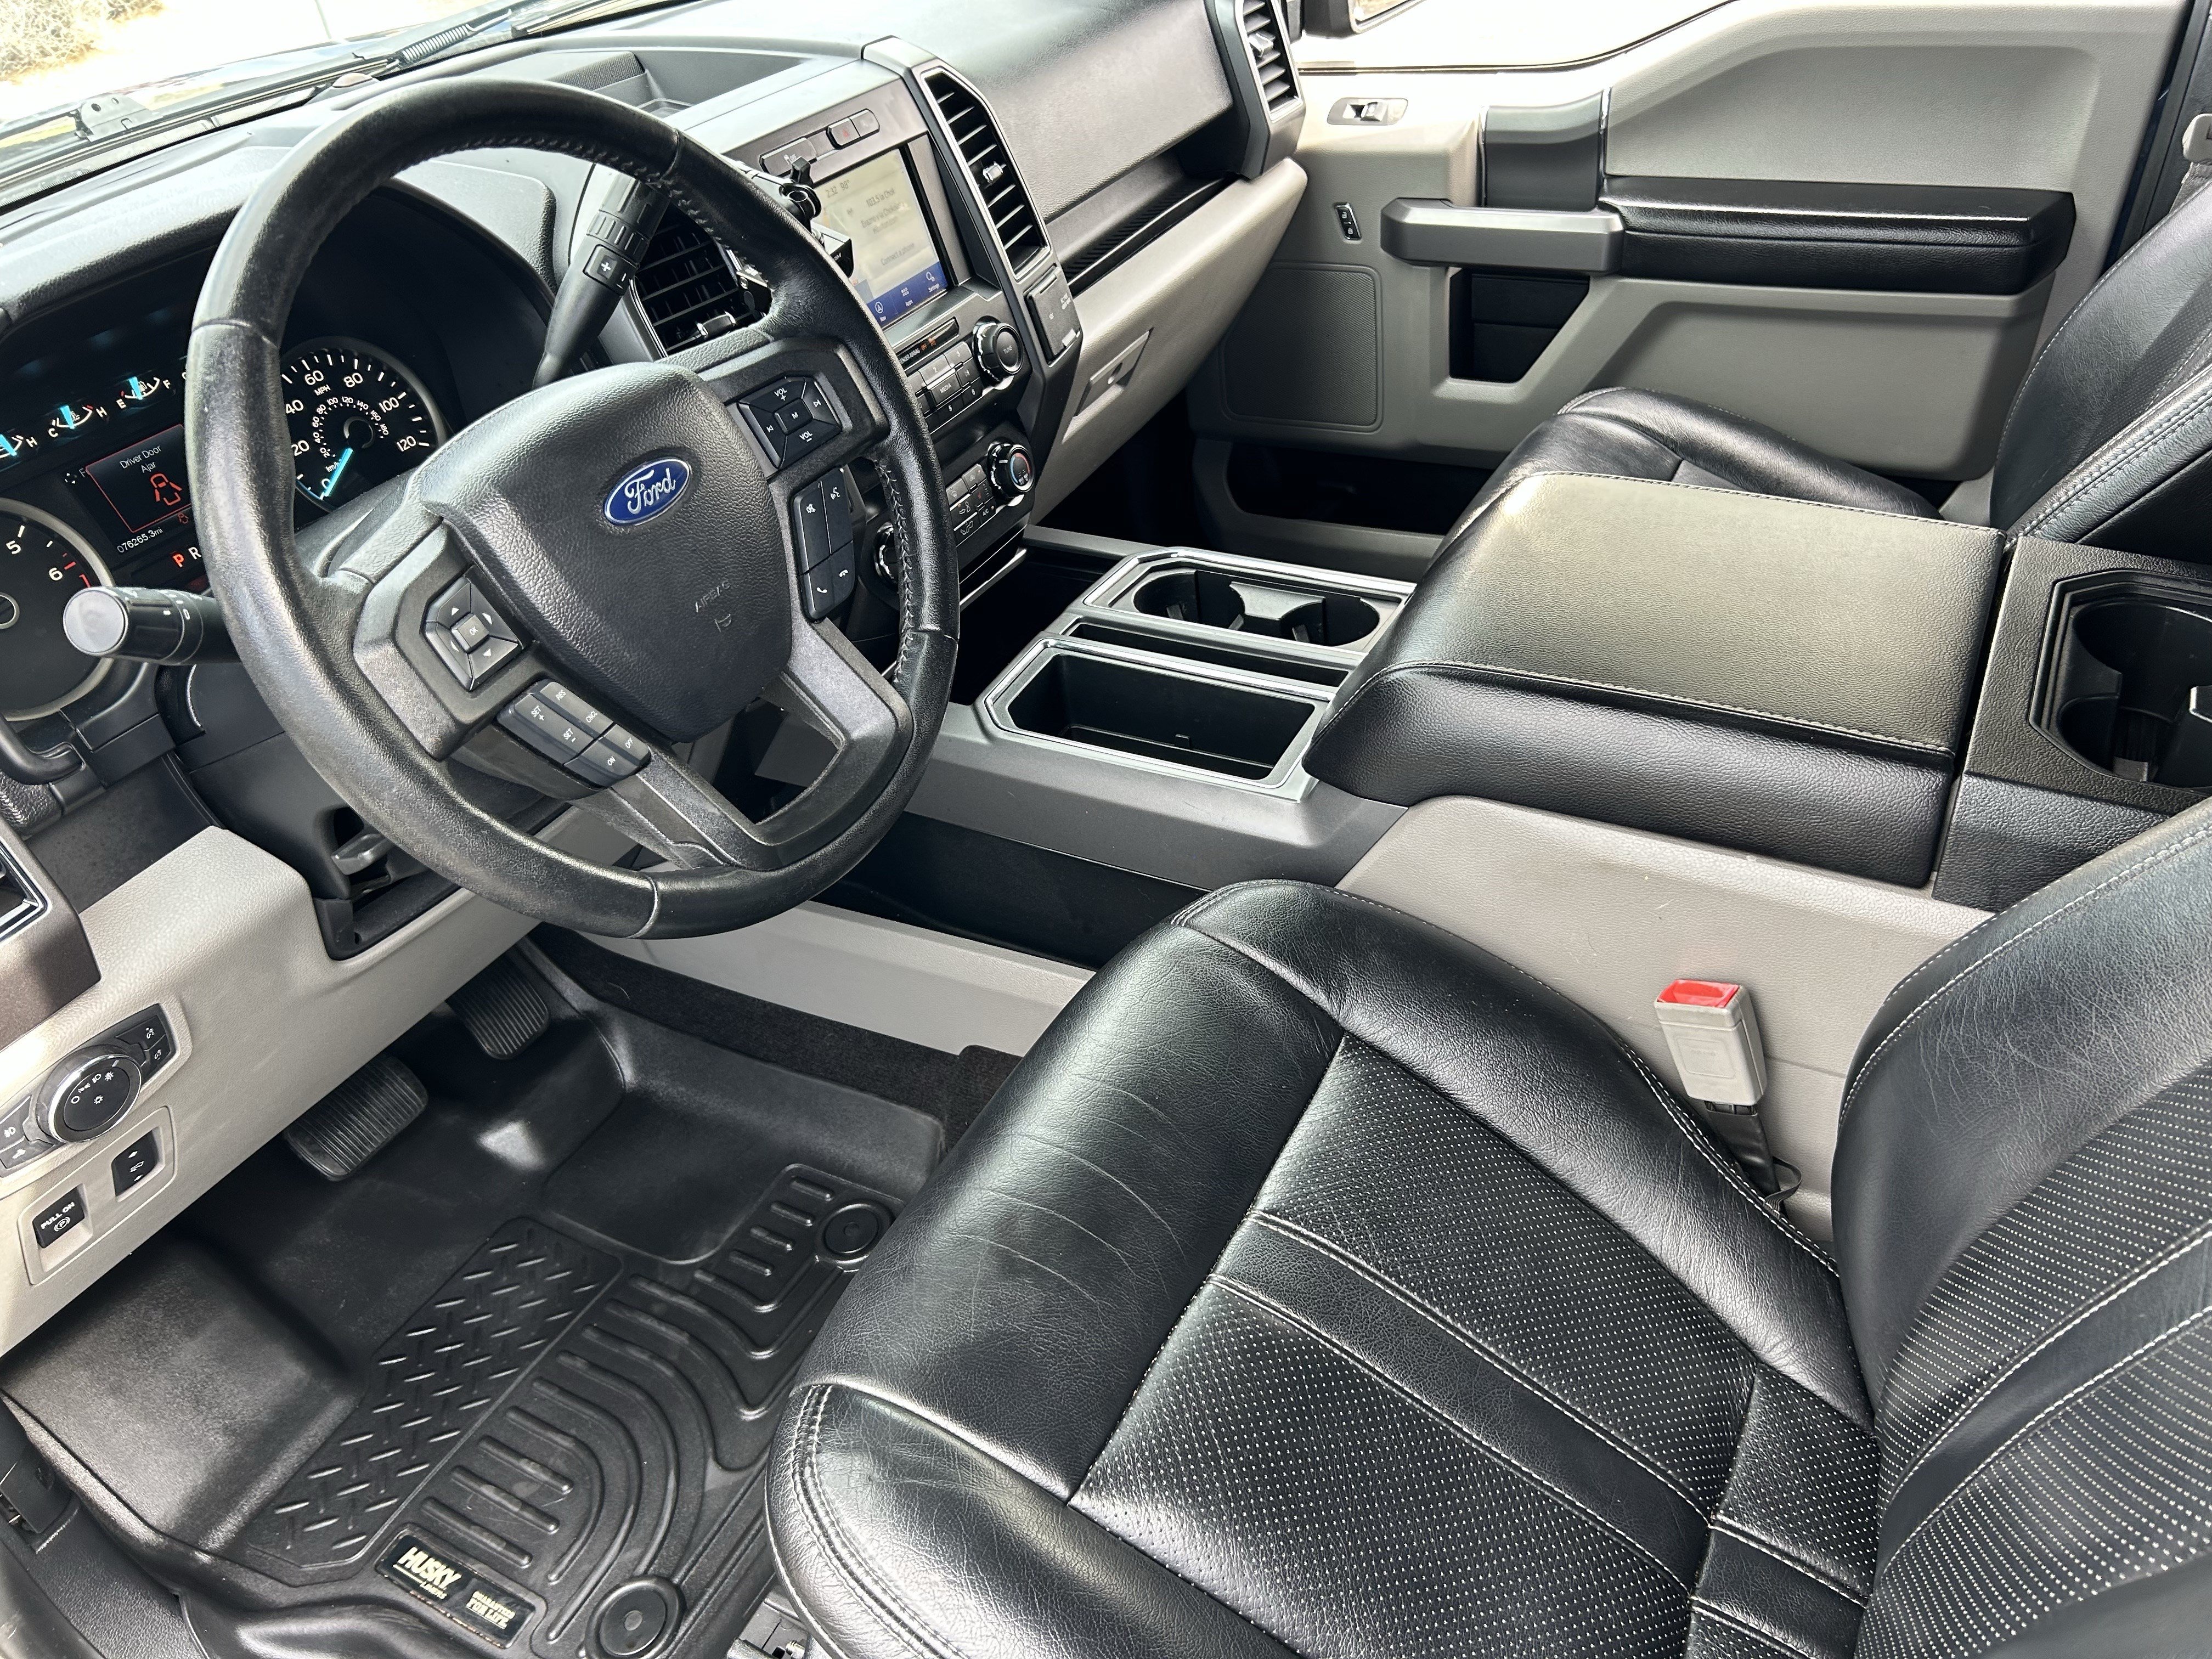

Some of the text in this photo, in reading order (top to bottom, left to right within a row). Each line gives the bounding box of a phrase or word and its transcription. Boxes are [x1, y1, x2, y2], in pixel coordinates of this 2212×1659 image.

[1003, 345, 1013, 354] TUNE
[163, 379, 171, 388] F
[304, 370, 324, 385] 60
[343, 373, 363, 388] 80
[314, 384, 331, 396] MPH
[774, 387, 788, 397] VOL
[939, 383, 952, 393] MEDIA
[116, 398, 127, 409] E
[285, 399, 304, 414] 40
[326, 397, 338, 405] 100
[356, 400, 369, 410] 140
[379, 397, 399, 413] 100
[96, 407, 107, 417] H
[317, 404, 326, 415] 80
[370, 410, 381, 421] 160
[312, 416, 320, 428] 60
[48, 428, 59, 437] C
[380, 424, 389, 435] 180
[313, 432, 321, 443] 40
[799, 431, 813, 441] VOL
[26, 437, 38, 448] H
[291, 440, 310, 456] 20
[396, 436, 416, 452] 120
[120, 445, 162, 469] Driver Door
[320, 447, 330, 458] 20
[141, 461, 156, 473] Ajar
[624, 467, 676, 514] Ford
[6, 540, 21, 555] 5
[188, 546, 201, 560] R
[173, 553, 184, 567] P
[49, 567, 63, 581] 6
[469, 626, 479, 636] OK
[556, 690, 566, 701] RES
[531, 706, 541, 718] SET
[586, 710, 598, 723] CNCL
[563, 728, 574, 740] SET
[625, 737, 633, 748] OFF
[607, 756, 616, 766] ON
[41, 1201, 75, 1229] PULL ON
[397, 1546, 462, 1590] HUSKY
[466, 1598, 487, 1616] FOR
